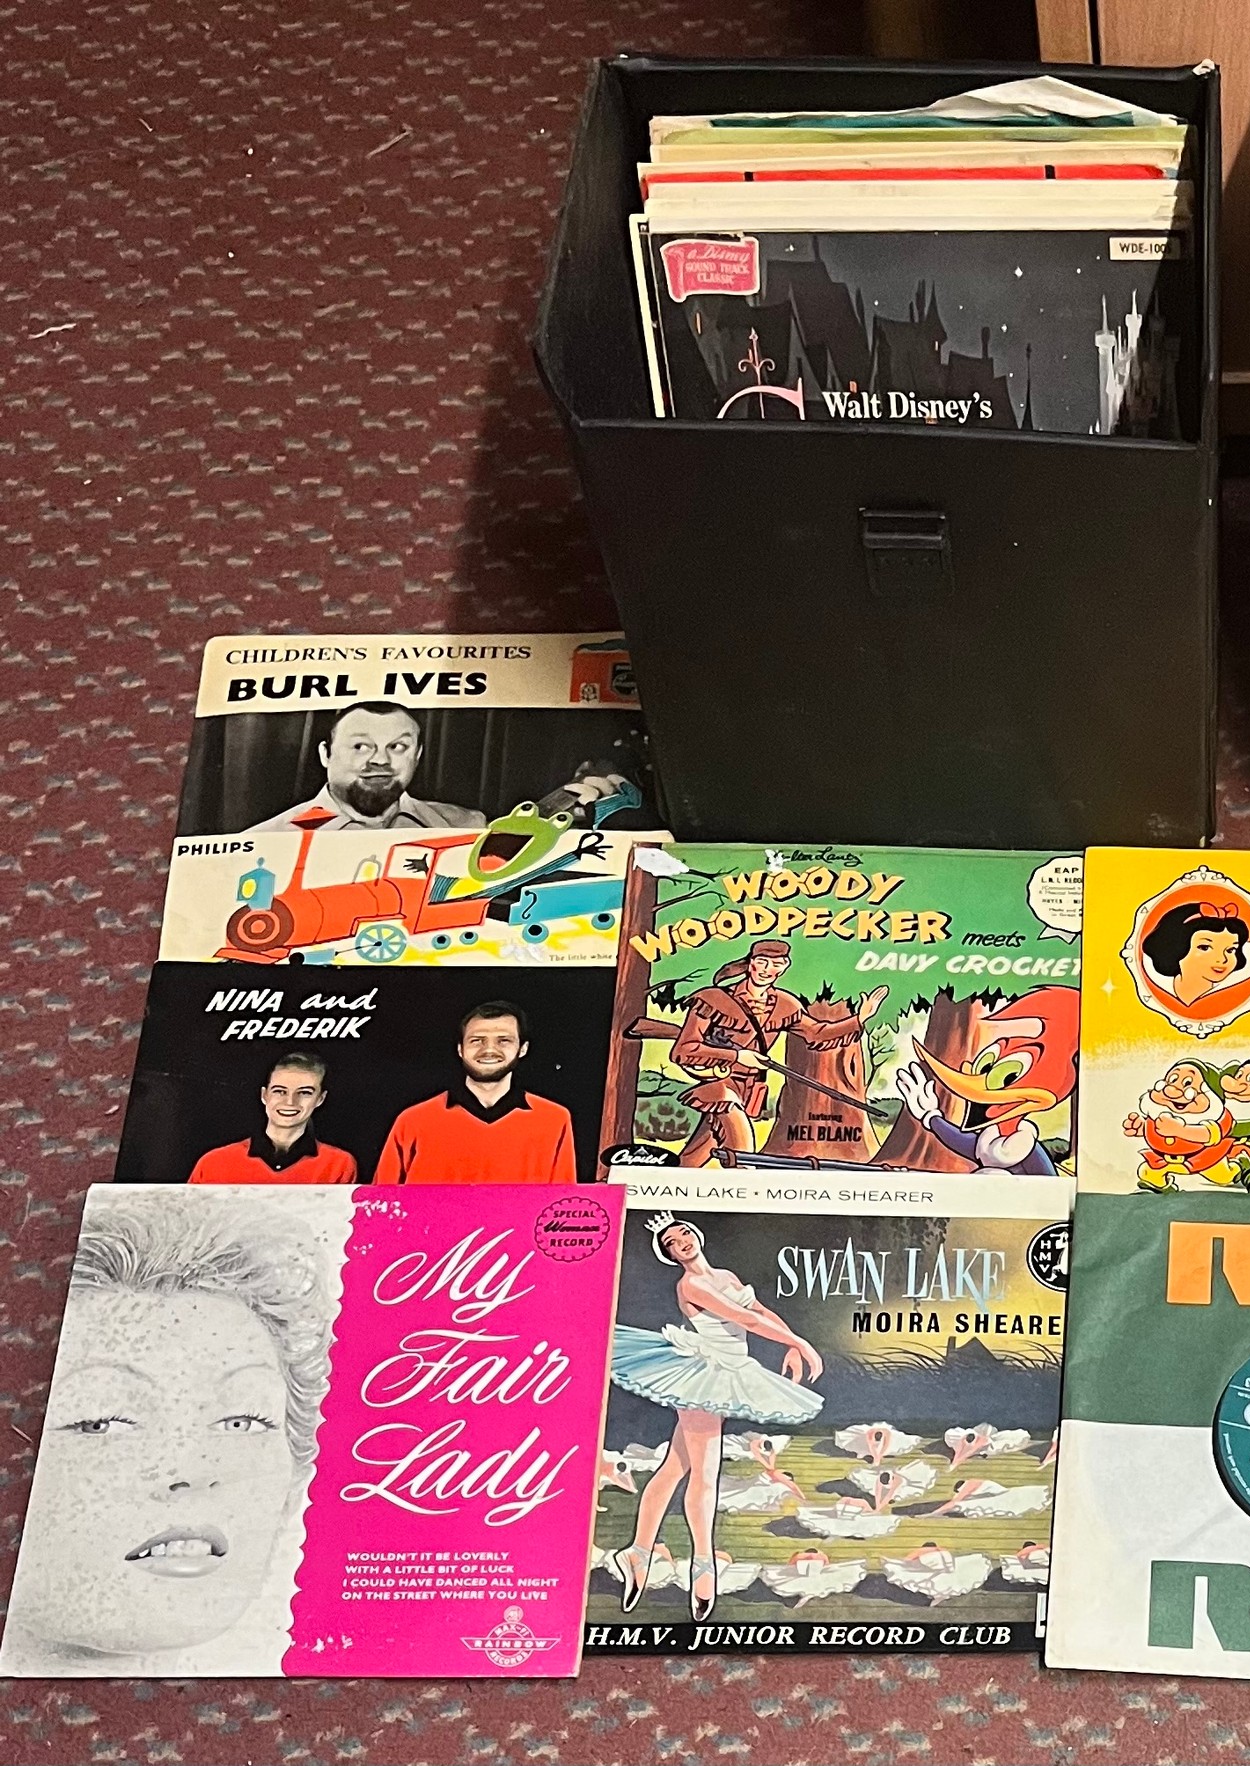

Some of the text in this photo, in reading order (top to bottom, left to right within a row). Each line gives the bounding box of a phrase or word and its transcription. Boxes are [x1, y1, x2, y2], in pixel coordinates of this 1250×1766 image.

[822, 391, 993, 424] Walt Disney's
[225, 645, 532, 665] CHILDREN'S FAVOURITES
[227, 671, 488, 702] BURL IVES
[177, 840, 255, 857] PHILIPS
[722, 866, 905, 905] WOODY
[629, 906, 953, 964] WOODPECKER
[961, 930, 1026, 949] meets
[855, 950, 940, 973] DAVY
[205, 987, 379, 1012] NINA and
[220, 1015, 372, 1042] FREDERIK
[786, 1124, 863, 1143] MEL BLANC
[610, 1148, 666, 1166] Capitol
[627, 1185, 934, 1203] SWAN LAKE MOIRA SHEARER
[553, 1210, 596, 1218] SPECIAL
[550, 1238, 593, 1247] RECORD
[373, 1227, 536, 1324] My
[776, 1237, 1006, 1314] SWAN LAKE
[852, 1311, 1061, 1335] MOIRA SHEARE
[360, 1328, 572, 1409] Fair
[339, 1419, 580, 1527] Lady
[347, 1552, 510, 1561] WOULDN'T IT BE LOVERLY
[345, 1565, 514, 1574] WITH A LITTLE BIT OF LUCK
[342, 1578, 559, 1587] I COULD HAVE DANCED ALL NIGHT
[341, 1591, 548, 1600] ON THE STREET WHERE YOU LIVE
[474, 1640, 547, 1648] RAINBOW
[586, 1626, 1012, 1650] H.M.V. JUNIOR RECORD CLUB
